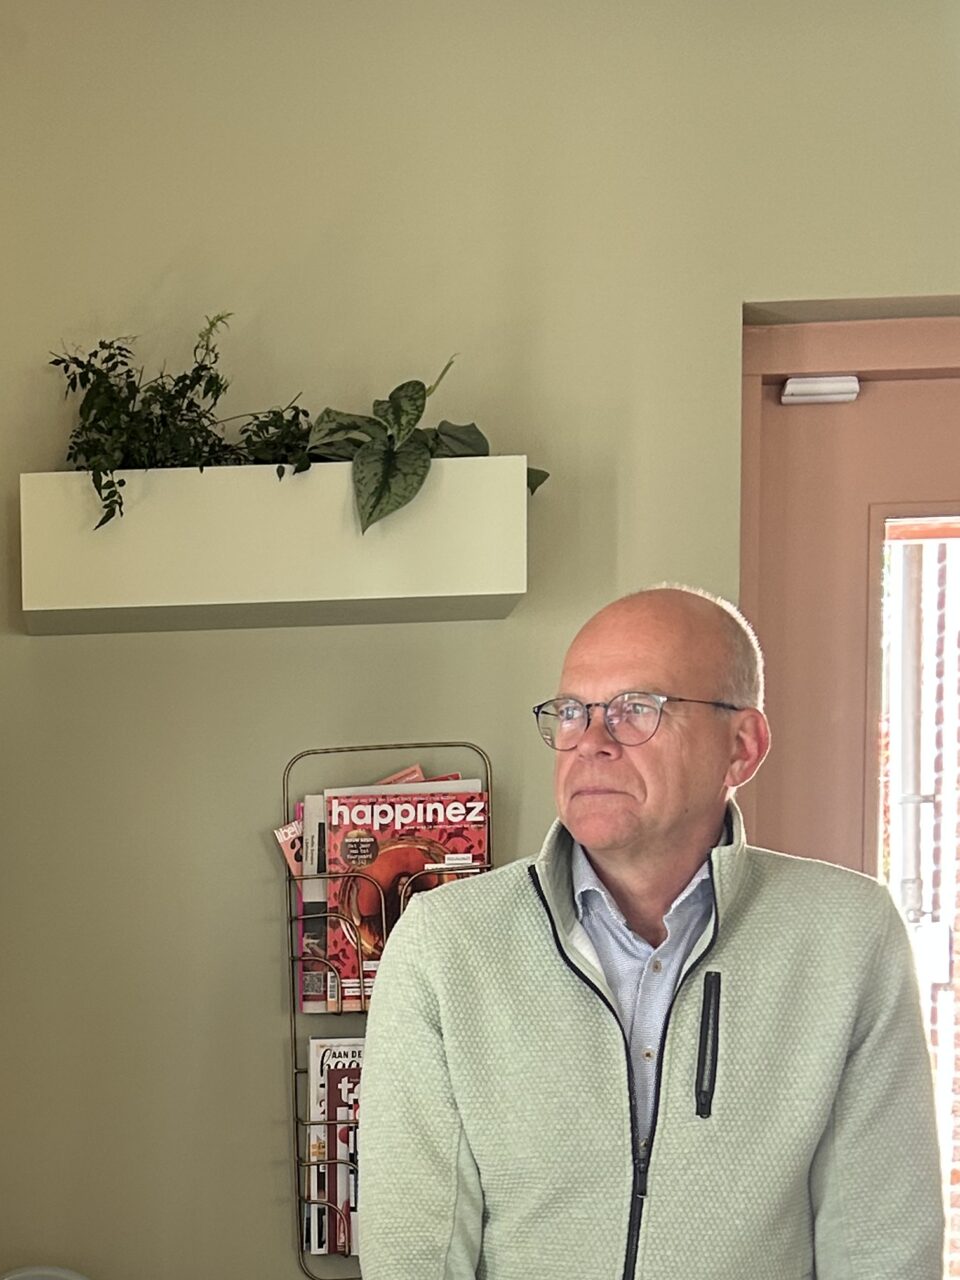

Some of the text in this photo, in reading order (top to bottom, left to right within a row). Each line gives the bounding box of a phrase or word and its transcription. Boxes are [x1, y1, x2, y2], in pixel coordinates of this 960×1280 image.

[331, 799, 485, 830] happinez
[274, 820, 302, 843] libell
[331, 1050, 362, 1059] AAN DE
